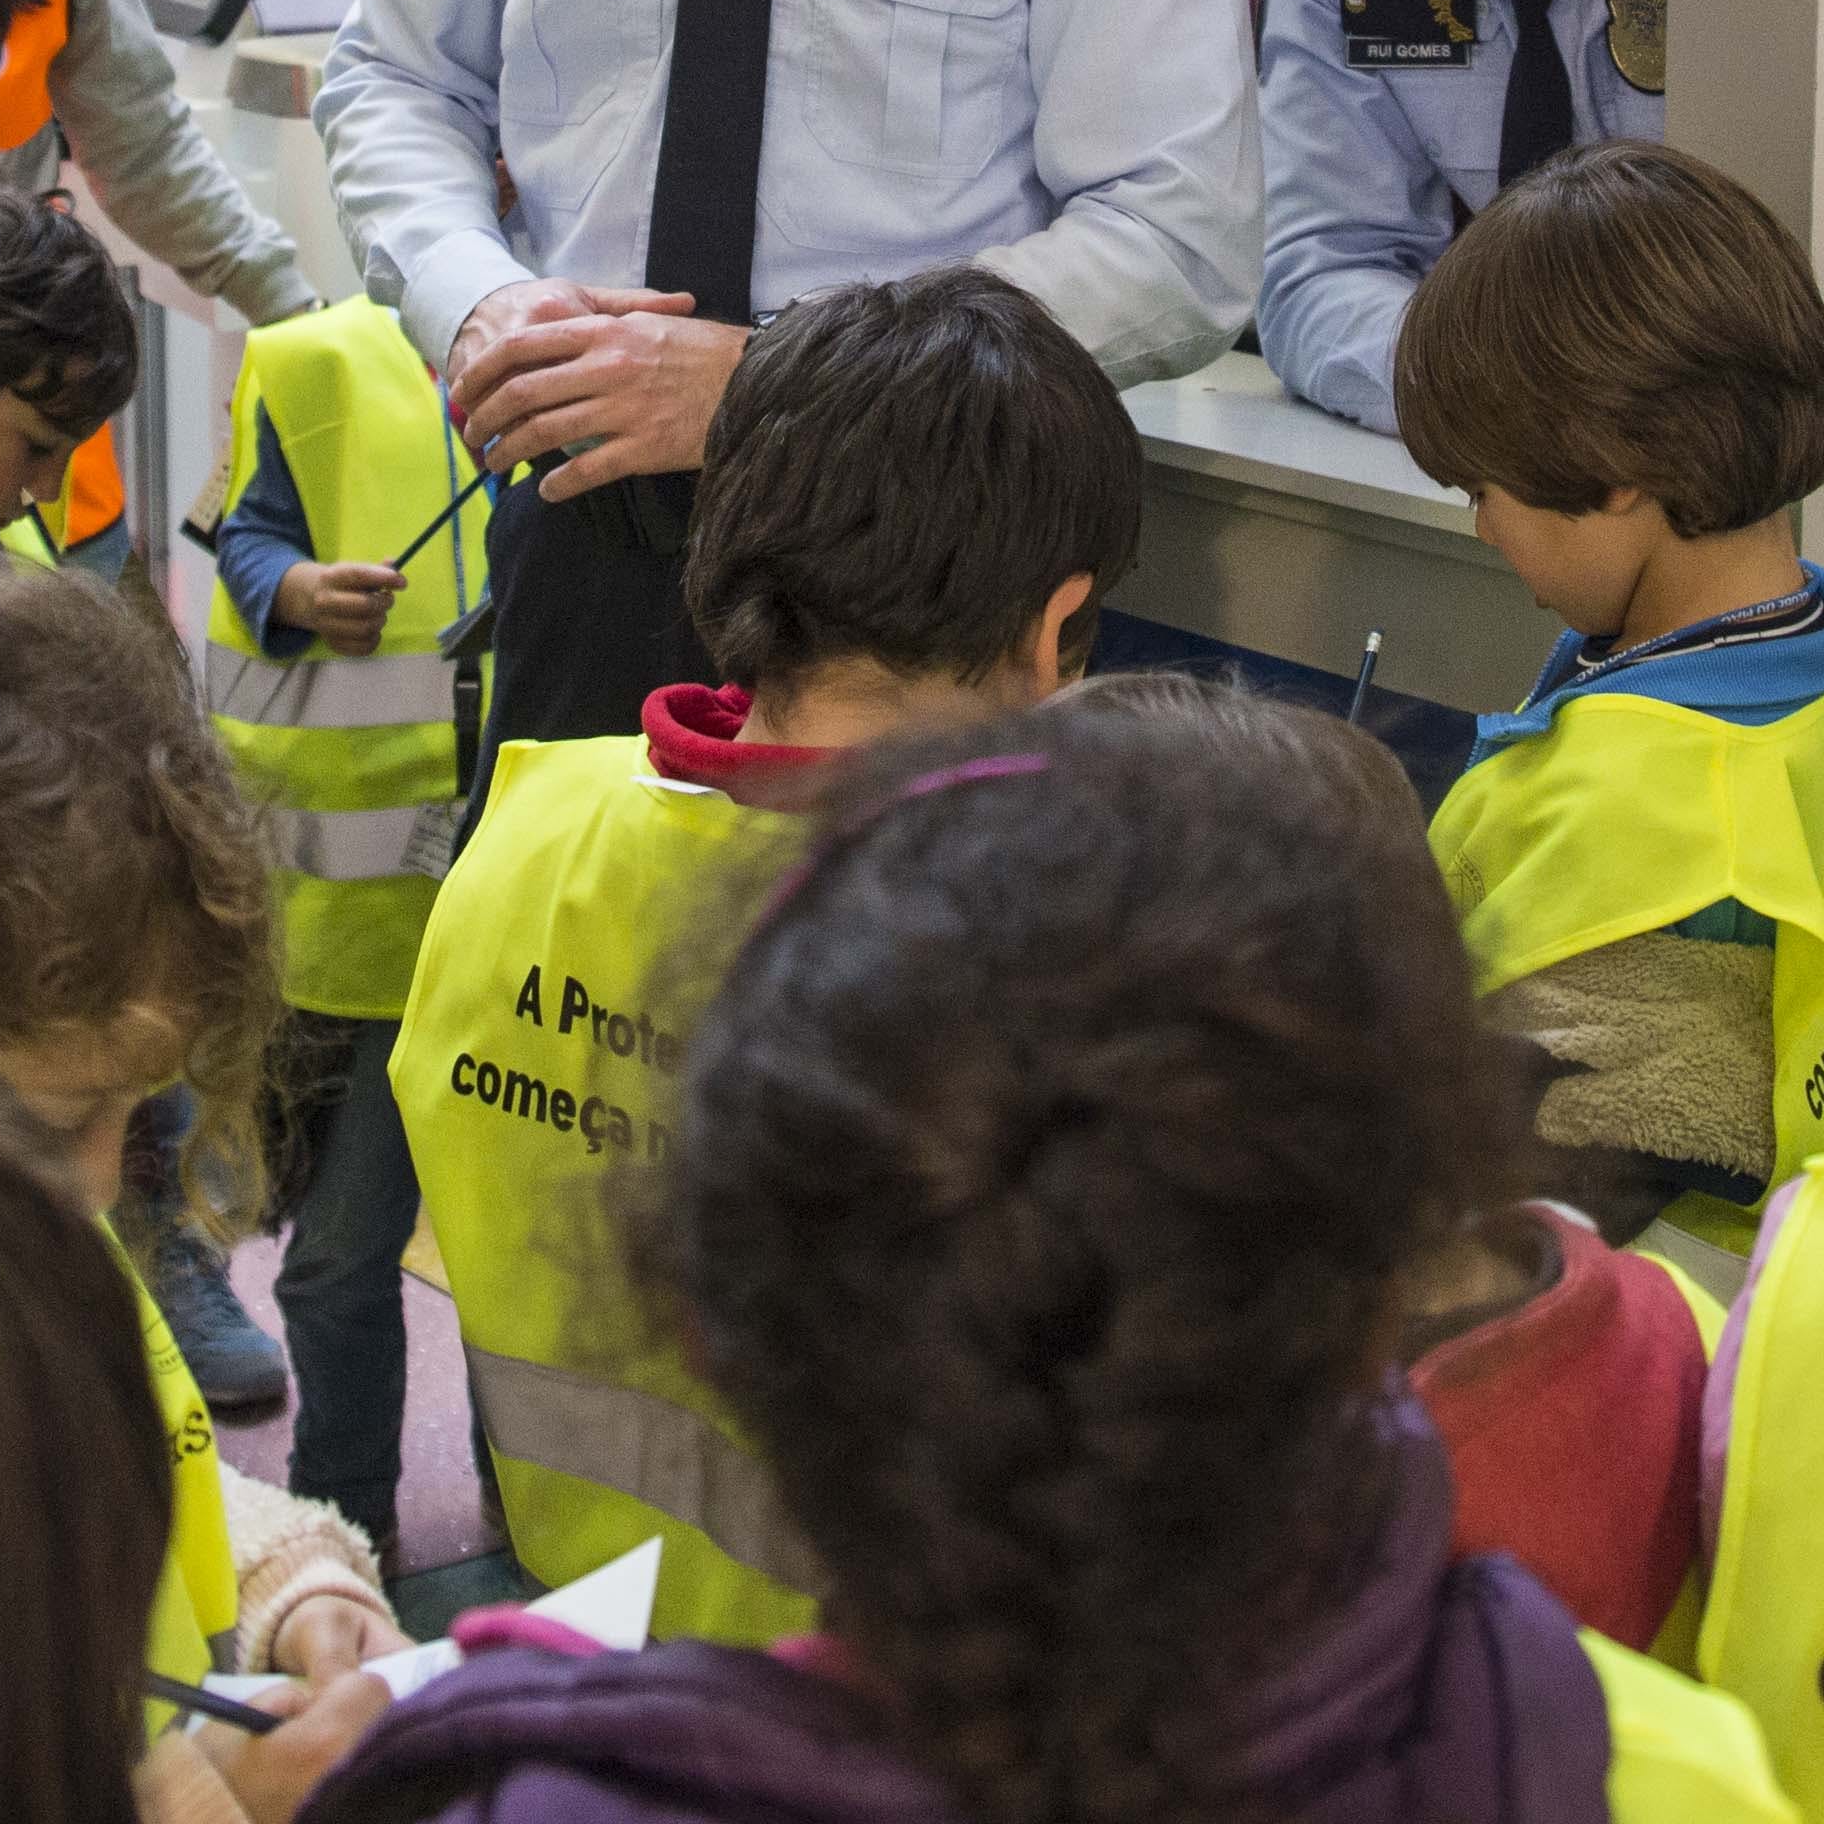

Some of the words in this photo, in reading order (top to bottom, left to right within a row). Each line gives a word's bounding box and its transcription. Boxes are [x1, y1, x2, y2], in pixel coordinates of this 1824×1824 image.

[1367, 44, 1392, 58] RUI
[1397, 44, 1452, 58] GOMES
[515, 964, 544, 1028] A
[450, 1051, 635, 1154] começa
